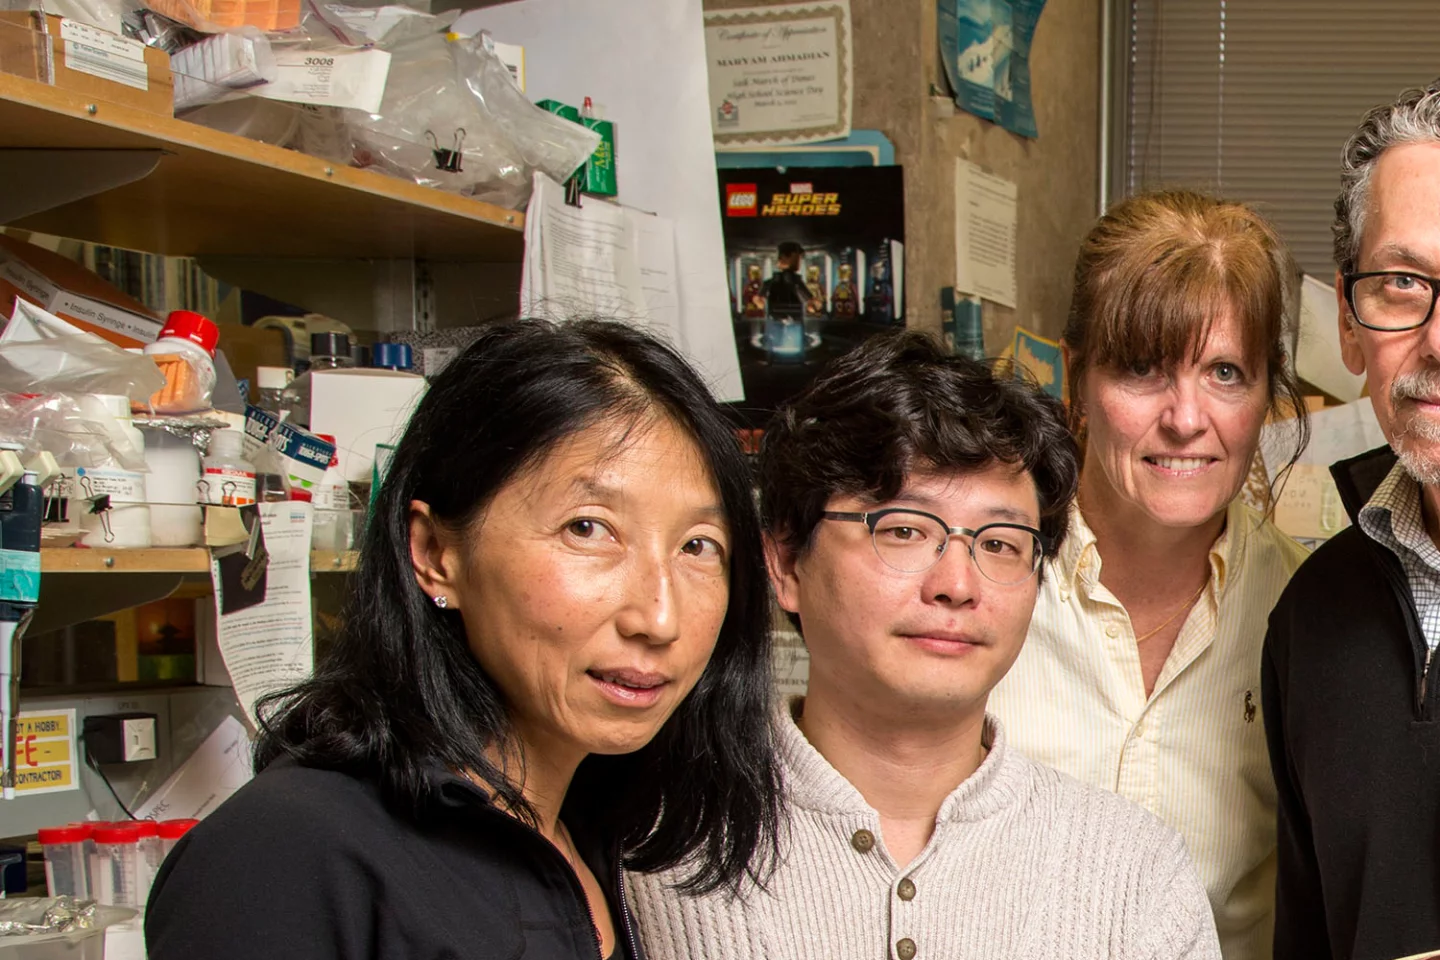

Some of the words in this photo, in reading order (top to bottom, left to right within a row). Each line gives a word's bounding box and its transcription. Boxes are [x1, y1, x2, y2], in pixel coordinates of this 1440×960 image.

[304, 57, 334, 66] 3008
[717, 55, 767, 67] MARYAM
[770, 51, 831, 64] AHMADIAN
[728, 193, 756, 208] LEGO
[772, 192, 839, 205] SUPER
[761, 203, 842, 217] HEROES
[26, 275, 50, 300] Syringe
[69, 302, 96, 319] Insulin
[96, 312, 126, 330] Syringe
